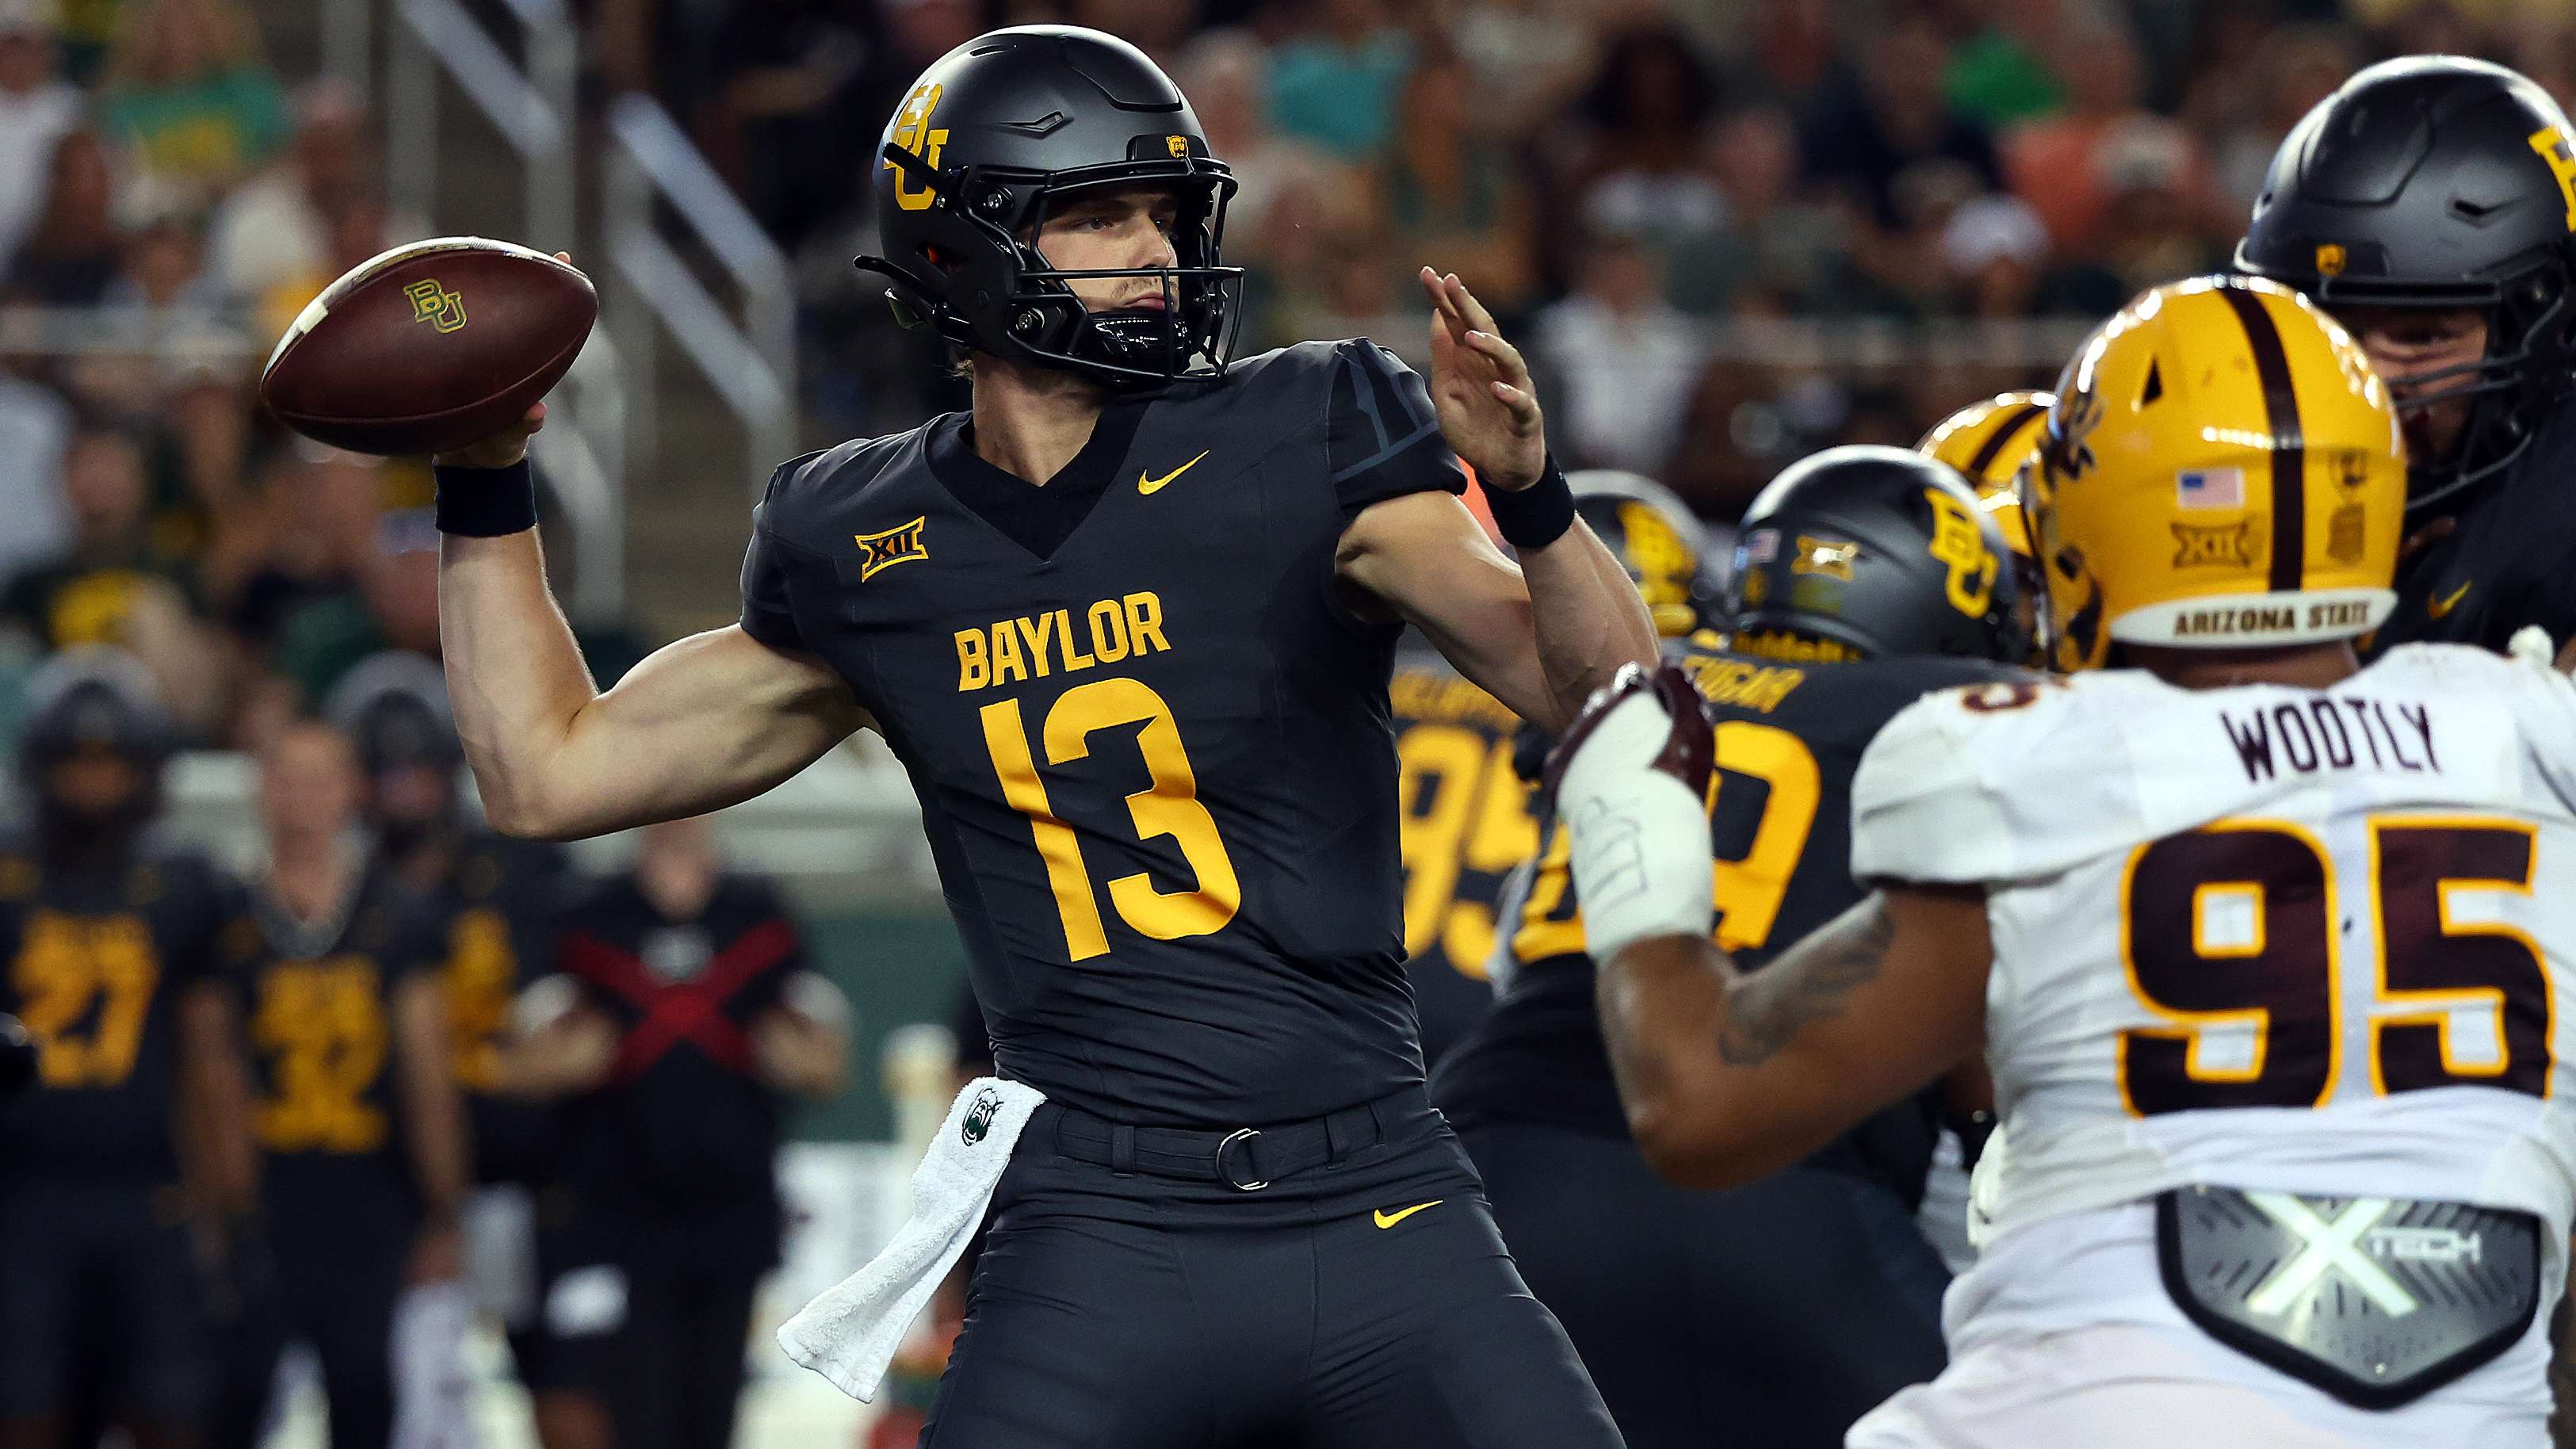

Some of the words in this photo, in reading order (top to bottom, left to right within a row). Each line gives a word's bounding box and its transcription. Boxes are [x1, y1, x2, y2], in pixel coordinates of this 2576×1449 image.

[403, 278, 467, 334] BU
[1923, 487, 2000, 620] BU
[954, 591, 1172, 692] BAYLOR
[2175, 607, 2296, 635] ARIZONA
[2307, 599, 2372, 631] STATE
[2219, 694, 2442, 786] WODTLY
[980, 677, 1241, 962] 13
[2115, 812, 2557, 1121] 95
